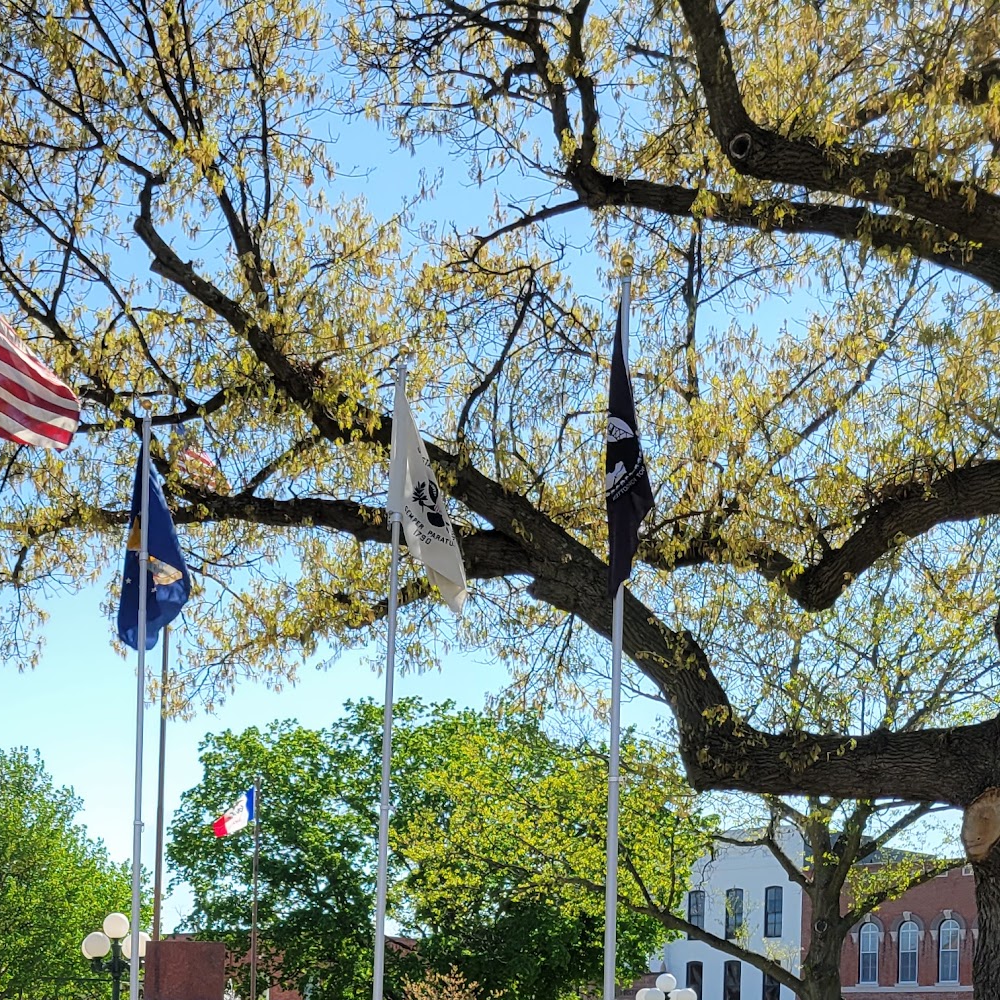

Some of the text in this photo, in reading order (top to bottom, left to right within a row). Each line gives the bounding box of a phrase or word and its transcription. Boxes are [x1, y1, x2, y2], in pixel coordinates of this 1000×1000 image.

[404, 505, 454, 547] SEMPER PARATU
[413, 529, 432, 545] 1790
